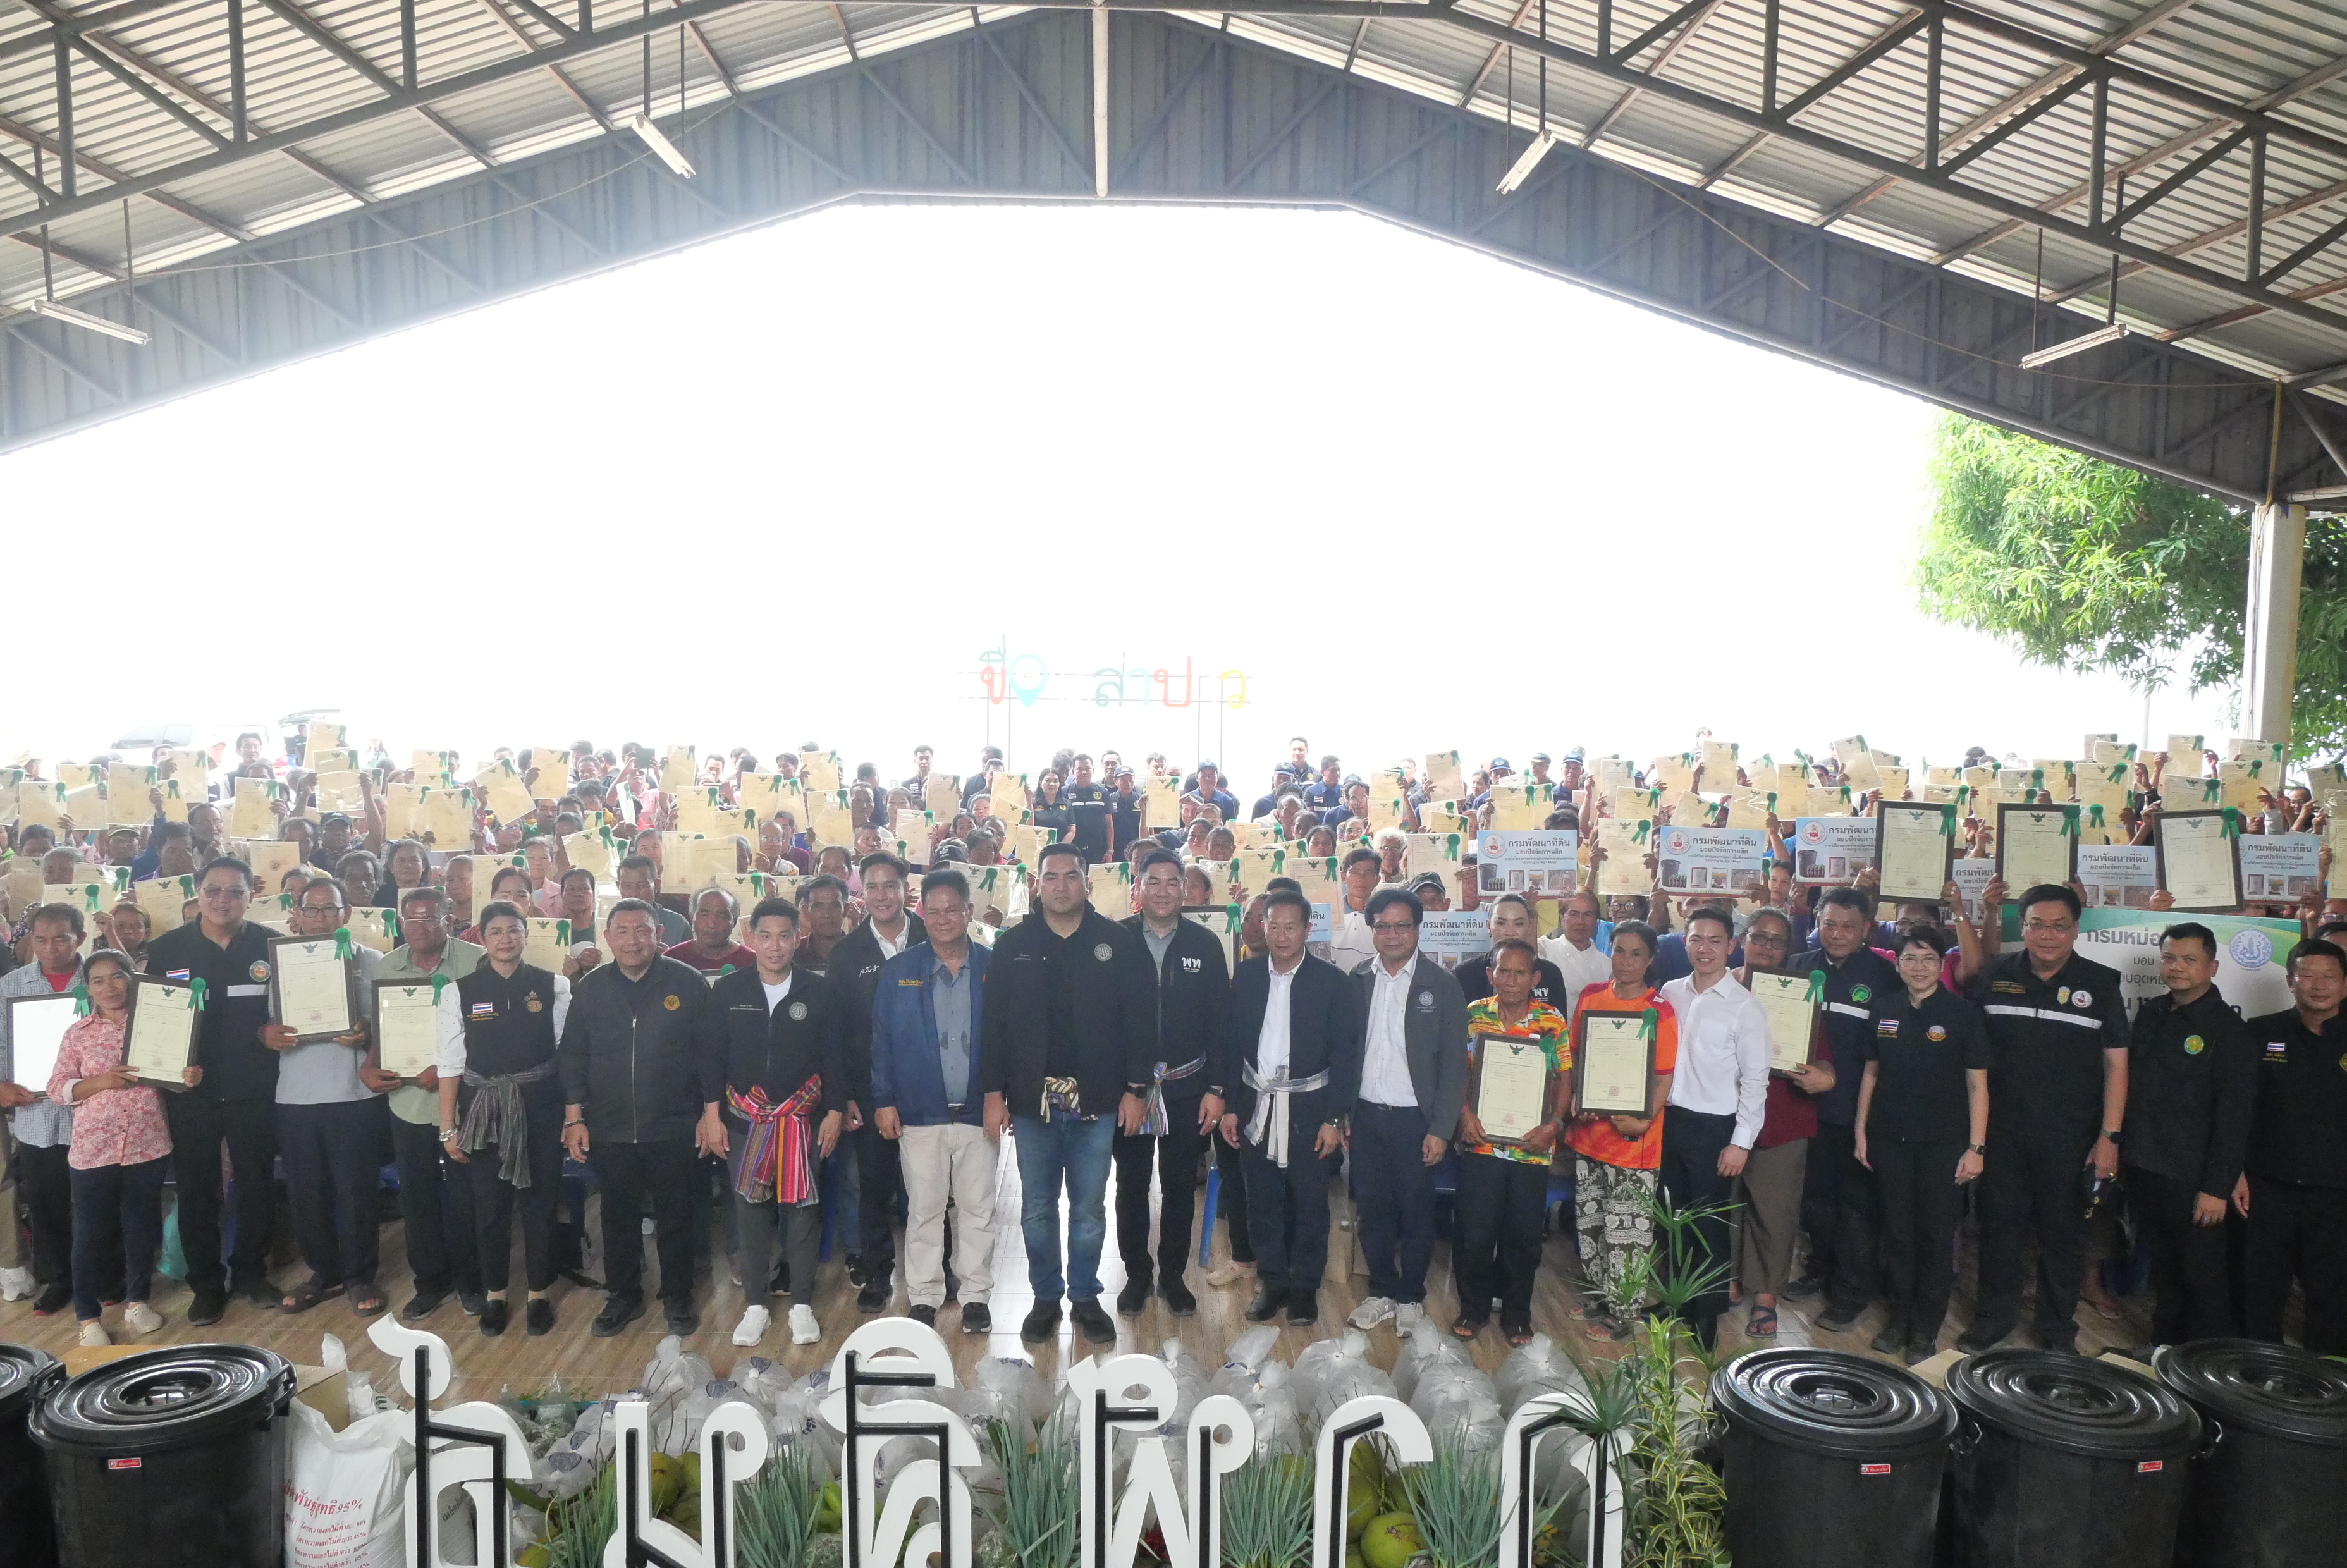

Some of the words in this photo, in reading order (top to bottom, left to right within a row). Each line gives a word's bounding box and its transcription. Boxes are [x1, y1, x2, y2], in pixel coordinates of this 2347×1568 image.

[1829, 824, 1877, 834] กรมพัฒนา
[1508, 835, 1570, 847] กรมพัฒนาที่ดิน
[1693, 834, 1757, 847] กรมพัฒนาที่ดิน
[2248, 841, 2312, 853] กรมพัฒนาที่ดิน
[2082, 850, 2148, 863] กรมพัฒนาที่ดิน
[1423, 916, 1484, 929] กรมพัฒนาที่ดิน
[2133, 957, 2154, 965] มอบ
[336, 1497, 364, 1514] 95%
